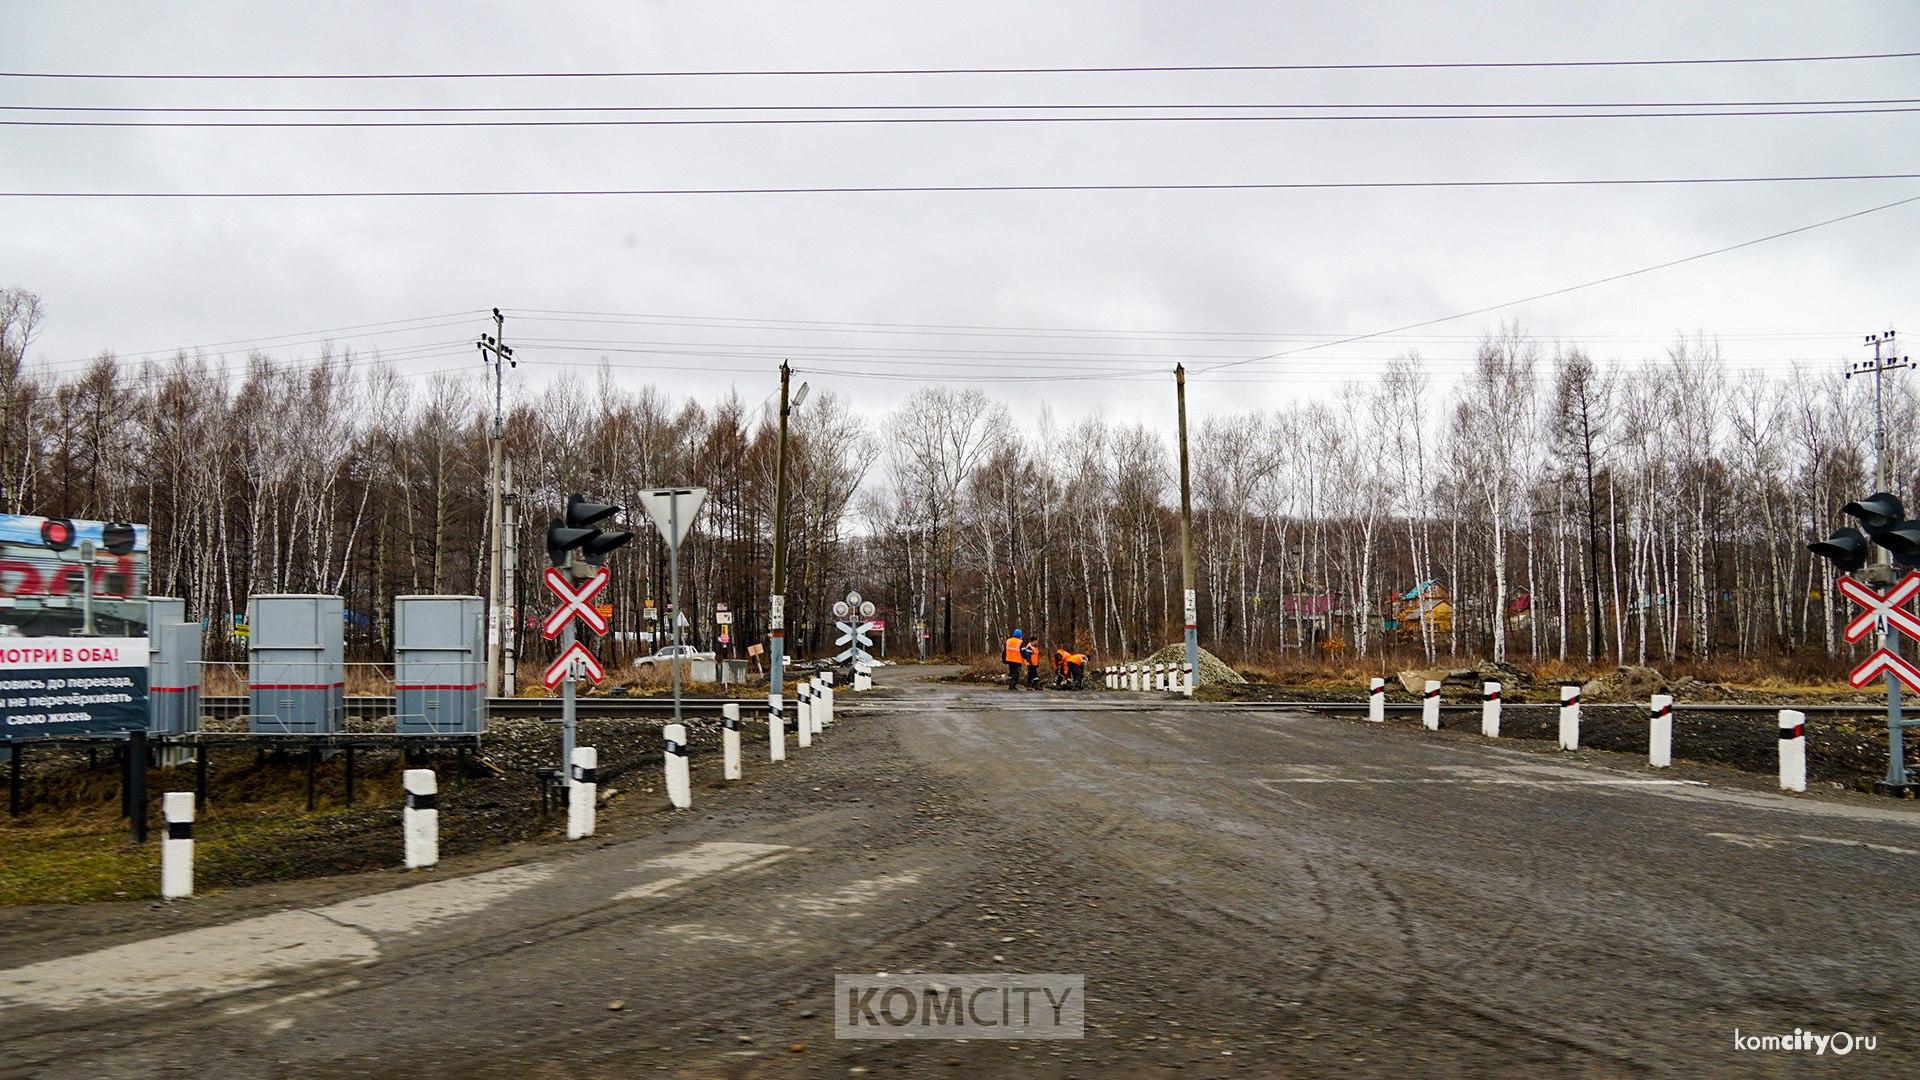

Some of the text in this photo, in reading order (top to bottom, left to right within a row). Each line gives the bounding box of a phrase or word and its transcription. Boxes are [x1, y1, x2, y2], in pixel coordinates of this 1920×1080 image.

[63, 648, 73, 662] В
[78, 648, 119, 662] ОБА!
[0, 677, 134, 690] овись до переезда,
[7, 697, 27, 707] не
[29, 692, 132, 707] перечёркивать
[6, 712, 92, 725] свою жизнь
